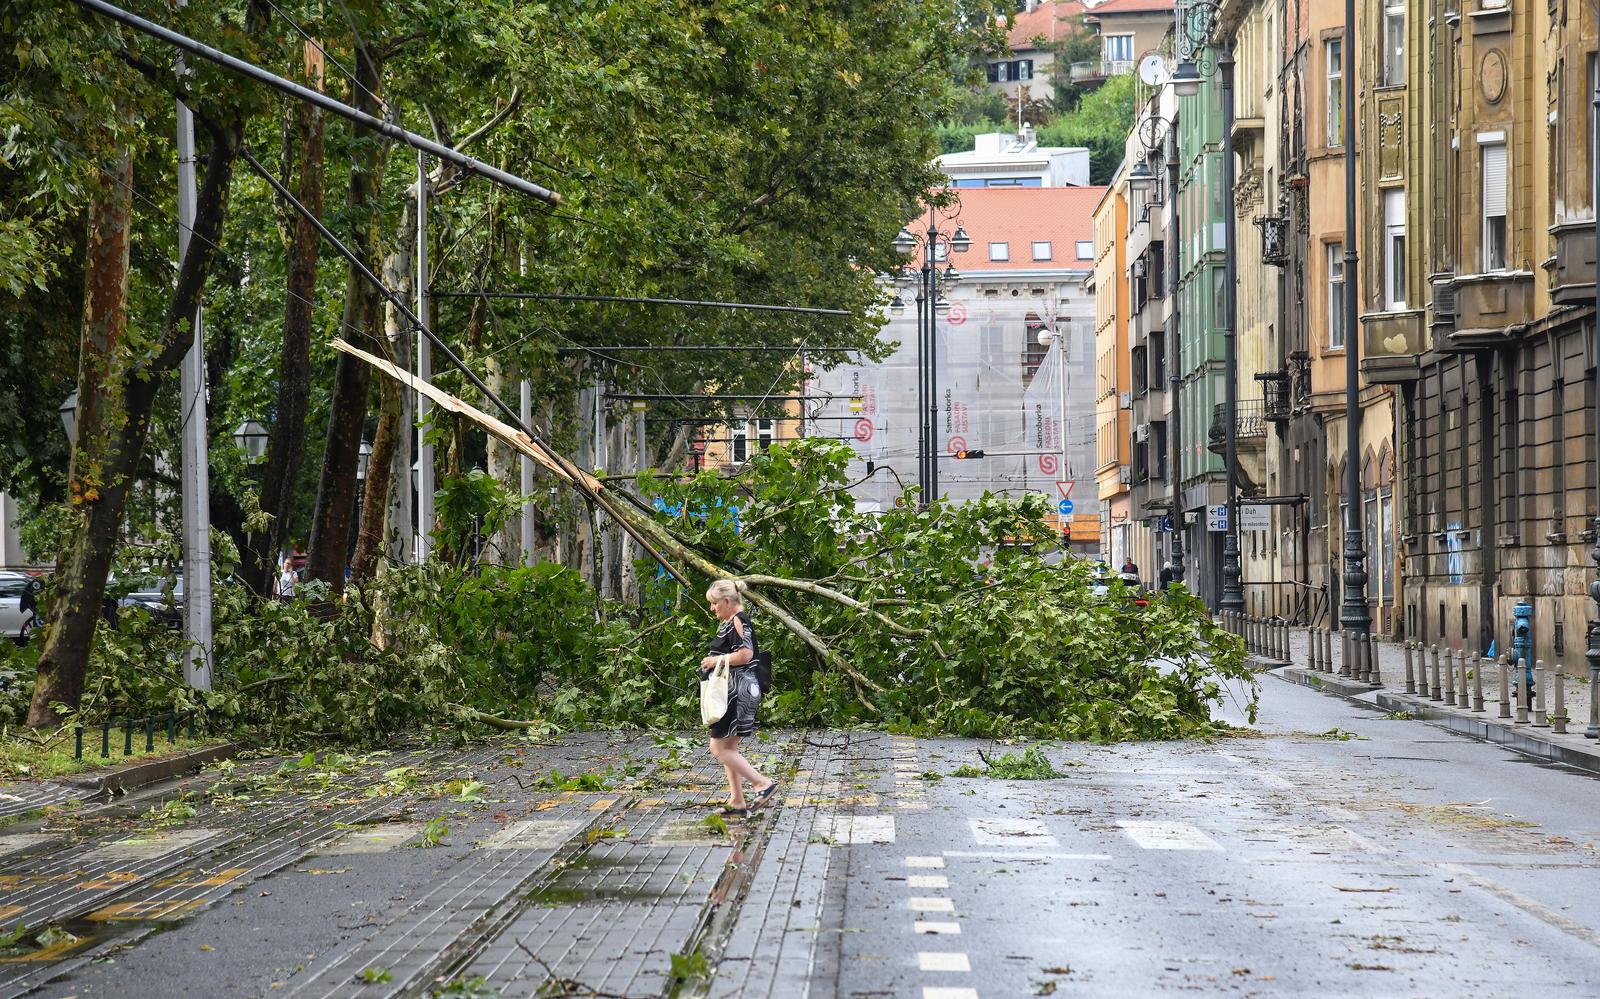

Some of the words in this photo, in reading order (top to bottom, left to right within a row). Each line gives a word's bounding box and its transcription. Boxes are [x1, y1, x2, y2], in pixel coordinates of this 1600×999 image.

[852, 372, 860, 416] Sborka
[944, 389, 952, 433] Samoborka
[1035, 404, 1043, 449] Samoborka
